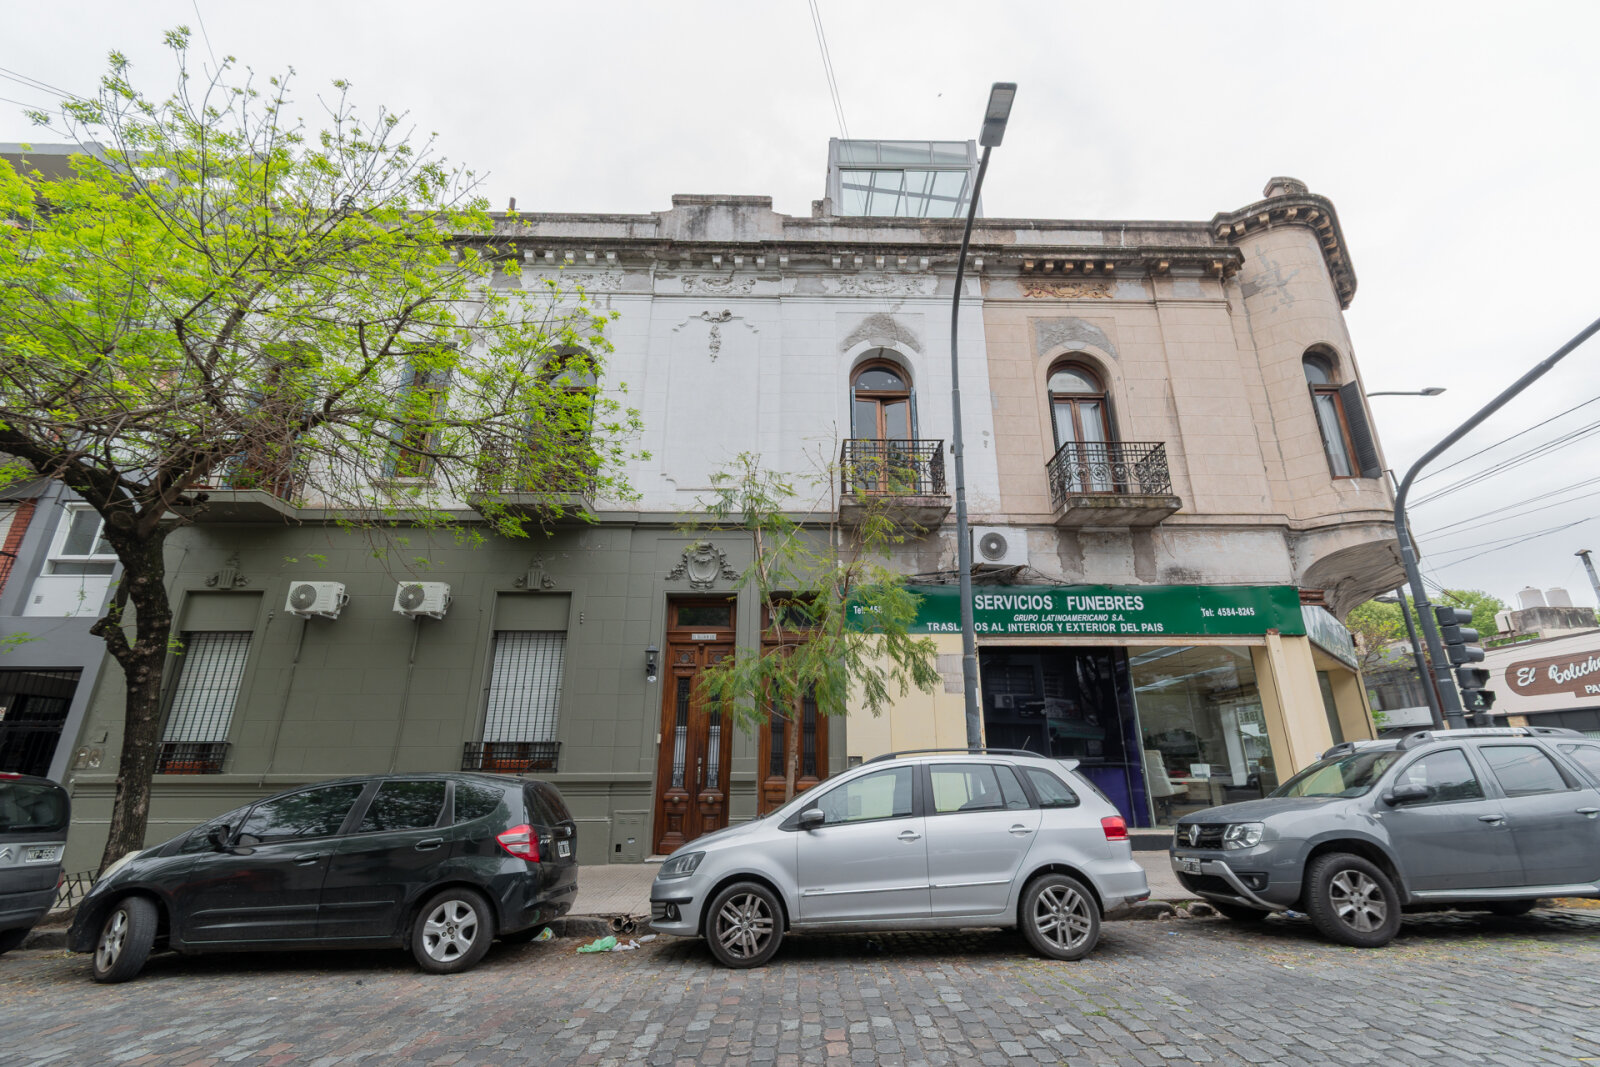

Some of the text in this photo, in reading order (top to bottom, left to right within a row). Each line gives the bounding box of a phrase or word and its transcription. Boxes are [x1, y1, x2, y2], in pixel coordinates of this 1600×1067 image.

[974, 594, 1145, 611] SERVICIOS FUNEBRES
[1200, 607, 1256, 617] Tel: 4584-8245
[1013, 613, 1126, 622] GRUPO LATINOAMERICANO S.A.
[926, 622, 1164, 632] TRASLOS AL INTERIOR Y EXTERIOR DEL PAIS
[1516, 667, 1537, 687] El
[1584, 684, 1600, 694] PA
